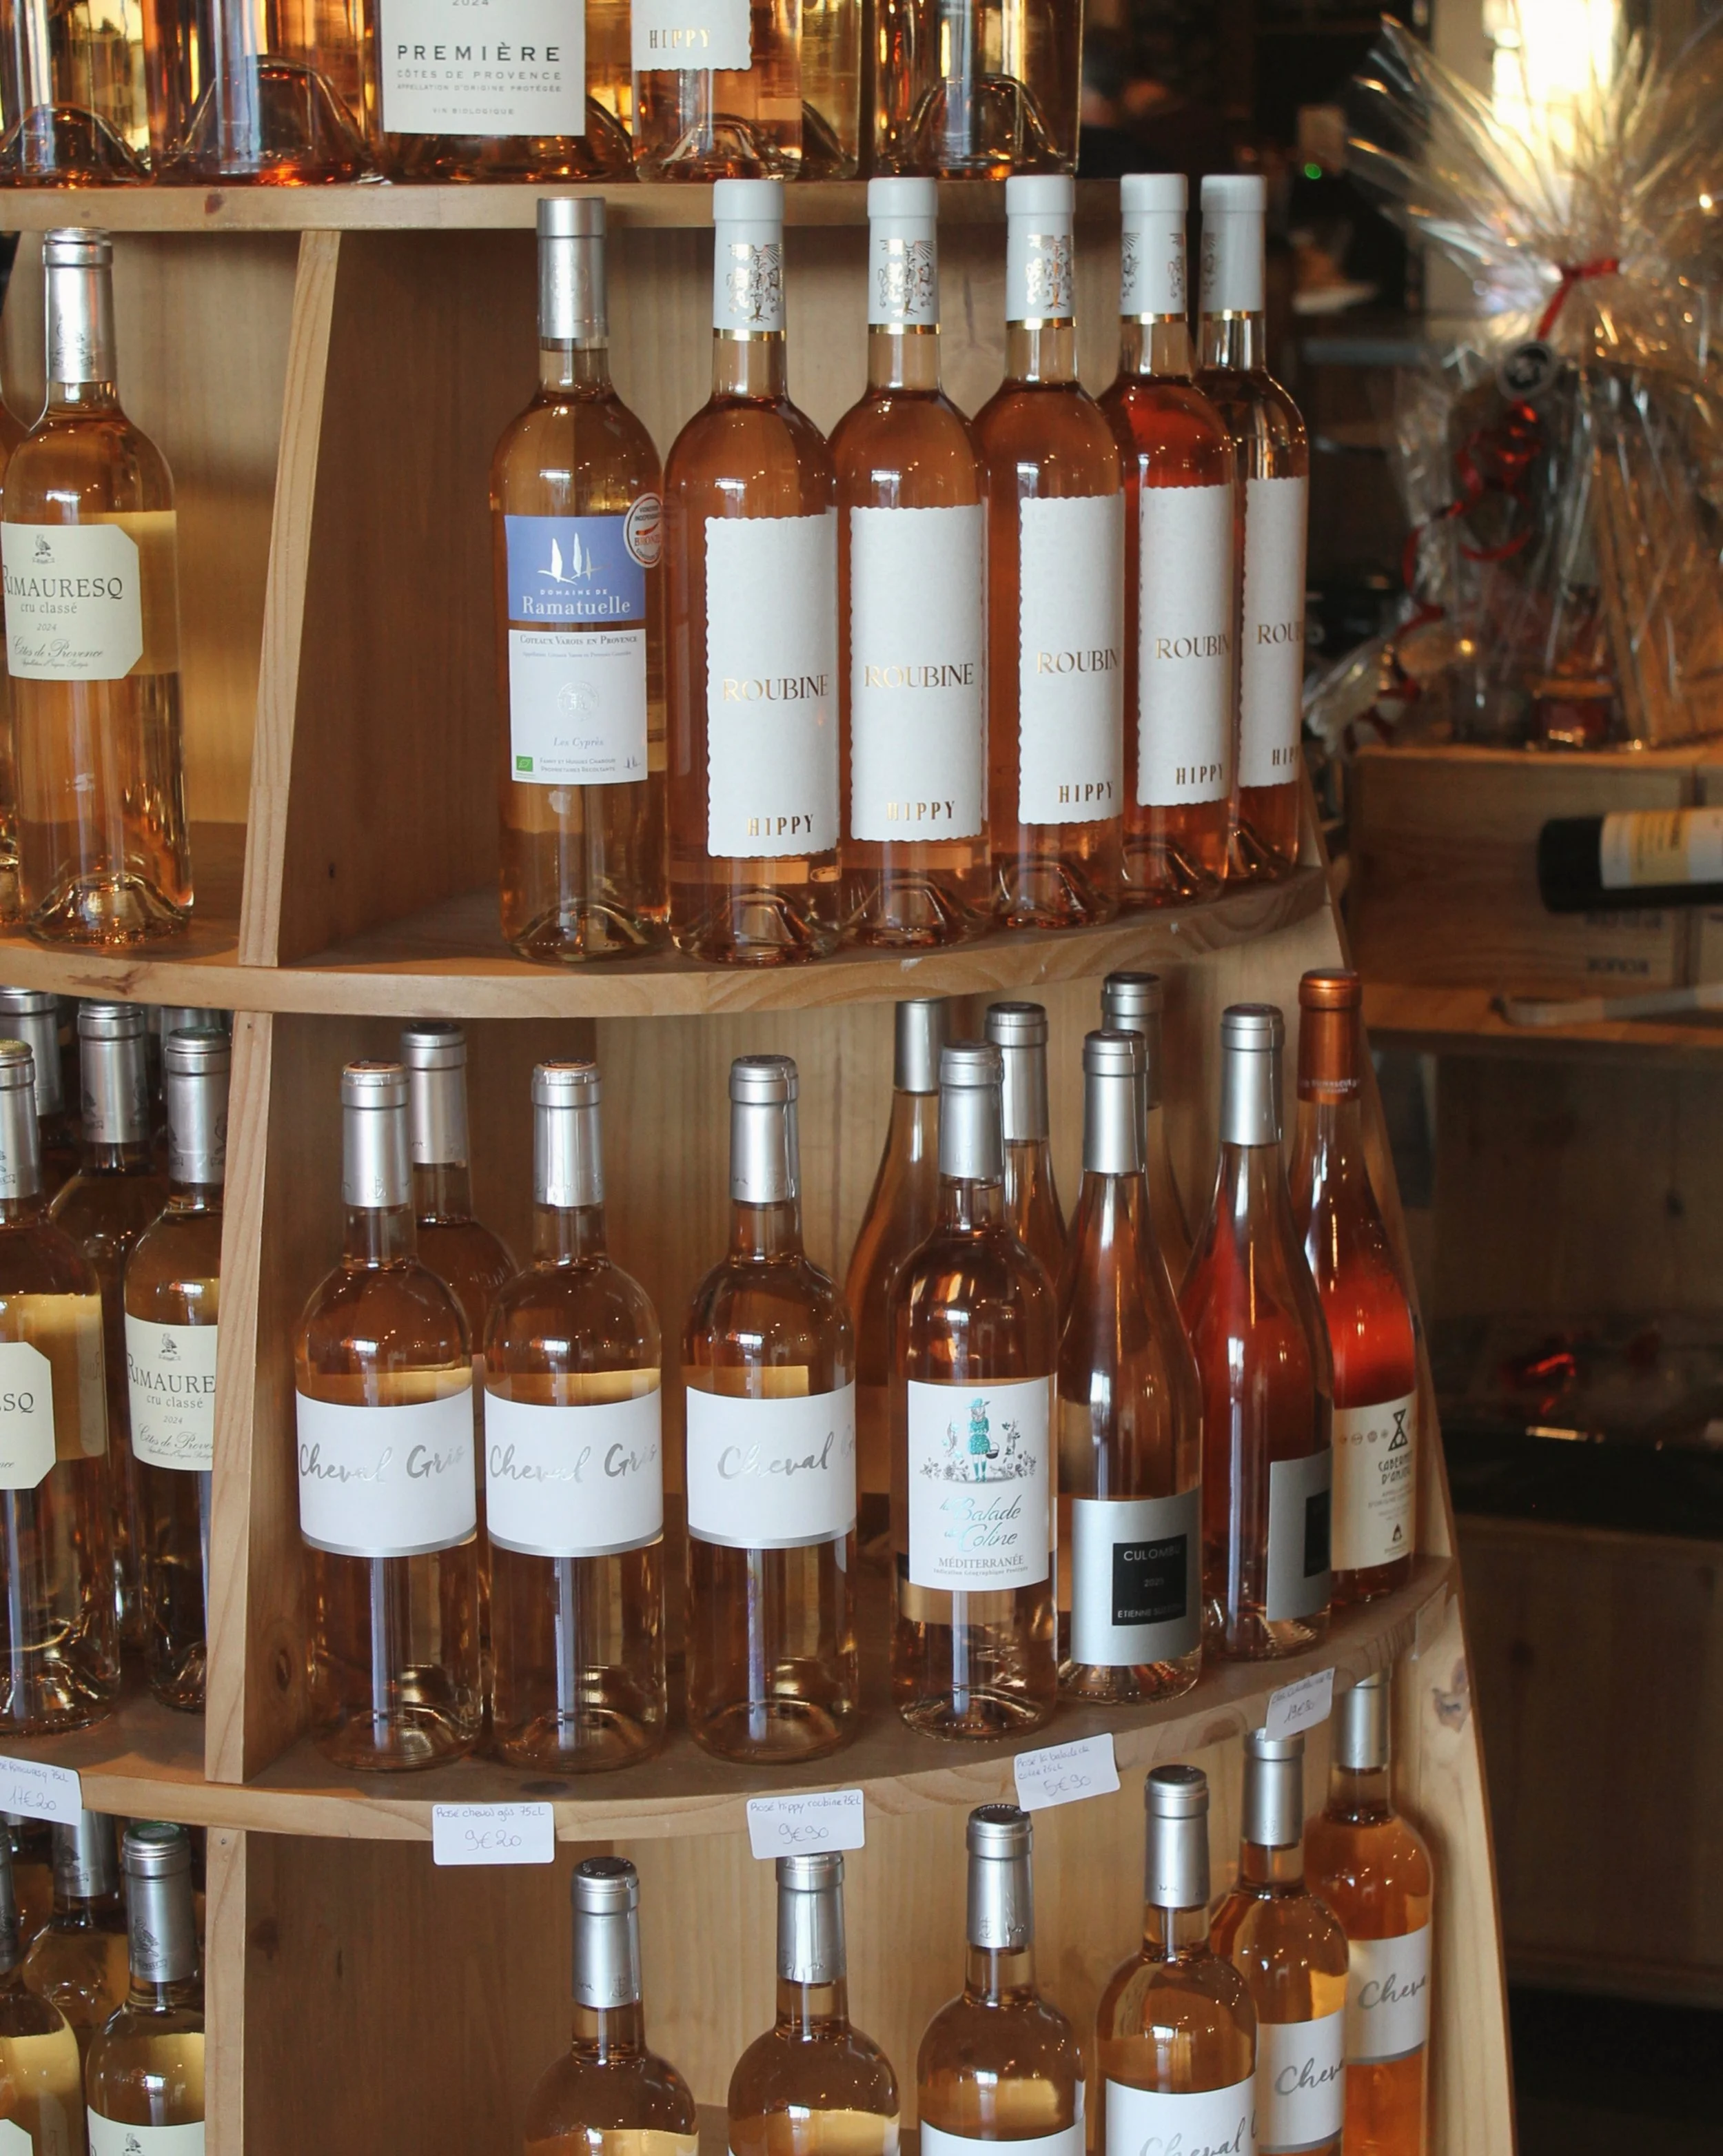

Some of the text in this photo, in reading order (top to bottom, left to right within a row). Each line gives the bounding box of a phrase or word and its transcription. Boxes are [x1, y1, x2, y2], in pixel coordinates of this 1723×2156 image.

[649, 29, 711, 50] HIPPY
[397, 43, 560, 61] PREMIÈRE
[397, 70, 562, 80] CÔTES DE PROVENCE
[21, 602, 77, 613] cru classé
[522, 596, 631, 615] Ramatuelle
[865, 664, 973, 688] ROUBINE
[723, 675, 829, 701] ROUBINE
[553, 737, 604, 749] Les Cyprès
[1176, 764, 1223, 785] HIPPY
[1059, 782, 1113, 803] HIPPY
[887, 801, 955, 820] HIPPY
[747, 815, 813, 836] HIPPY
[0, 1392, 34, 1414] SQ
[147, 1395, 203, 1408] cru classé
[163, 1416, 183, 1424] 2024
[300, 1443, 465, 1484] Cheval Gris
[489, 1443, 657, 1483] Cheval Gris
[717, 1432, 834, 1480] Cheval
[952, 1494, 1022, 1521] Balade
[958, 1522, 1018, 1552] Coline
[939, 1554, 1023, 1568] MÉDITERRANÉE
[462, 1807, 494, 1818] cheval
[779, 1802, 804, 1814] hippy
[465, 1829, 522, 1851] 9€20
[778, 1823, 829, 1844] 9€90
